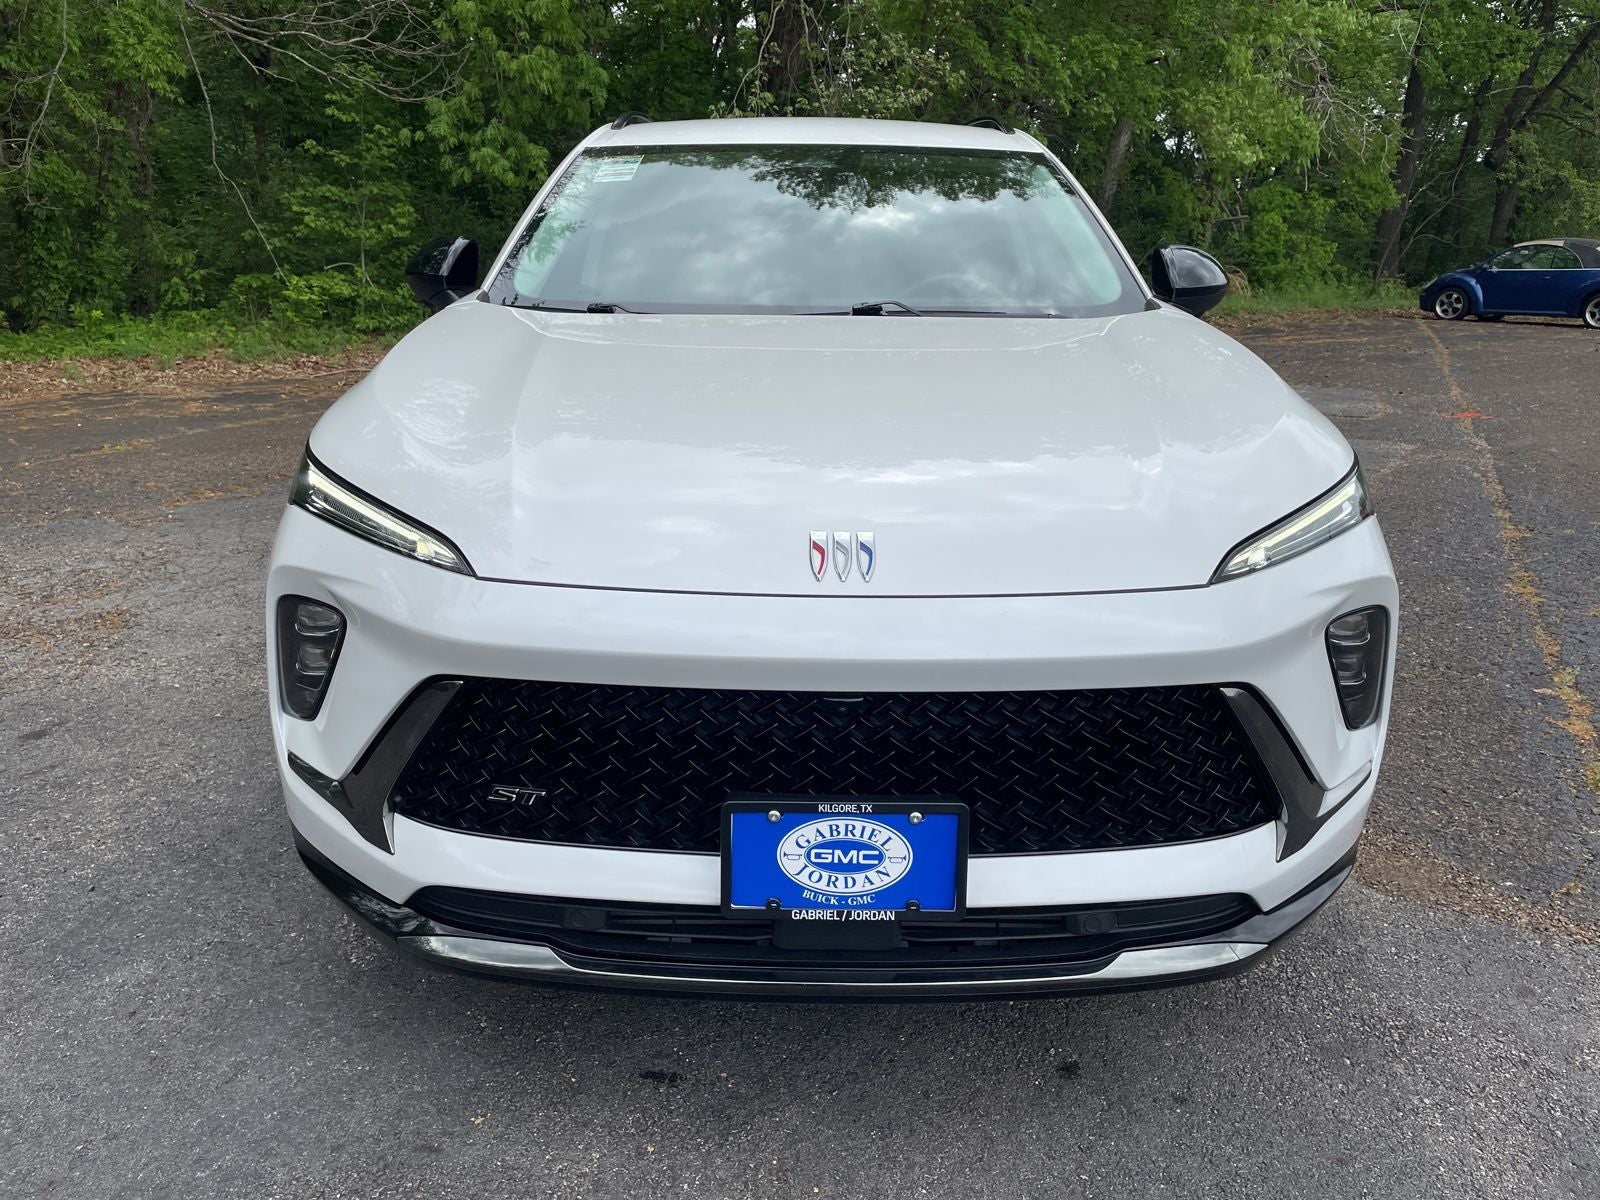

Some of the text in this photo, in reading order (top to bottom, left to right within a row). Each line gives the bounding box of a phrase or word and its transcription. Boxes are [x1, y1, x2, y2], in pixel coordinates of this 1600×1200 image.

[487, 785, 546, 805] ST
[818, 803, 873, 813] KILGORE, TX
[795, 823, 894, 852] GABRIEL
[810, 848, 880, 864] GMC
[793, 863, 892, 889] JORDAN
[802, 889, 839, 905] BUICK
[847, 894, 876, 906] GMC
[791, 909, 840, 920] GABRIEL
[849, 910, 895, 920] JORDAN
